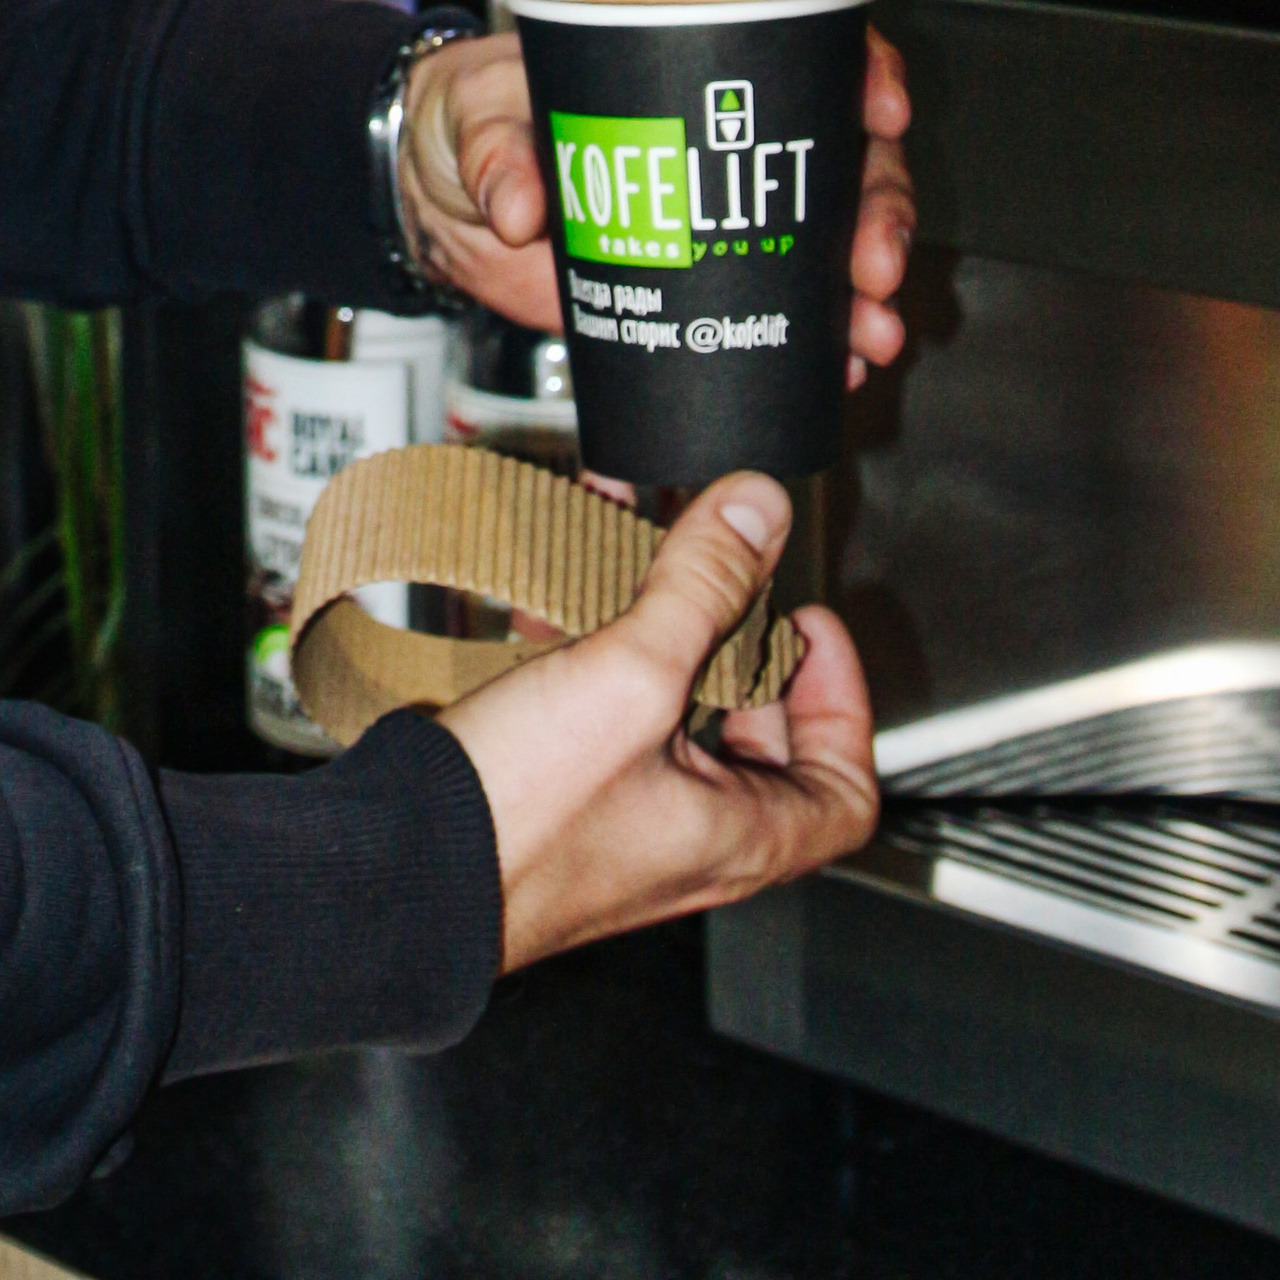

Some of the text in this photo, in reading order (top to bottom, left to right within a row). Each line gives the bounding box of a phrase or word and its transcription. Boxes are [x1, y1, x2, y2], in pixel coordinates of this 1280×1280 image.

[556, 139, 815, 231] KOFELIFT
[598, 234, 795, 261] takes you up
[613, 284, 663, 317] рады
[620, 318, 682, 353] сторис
[685, 312, 791, 354] @kofelift
